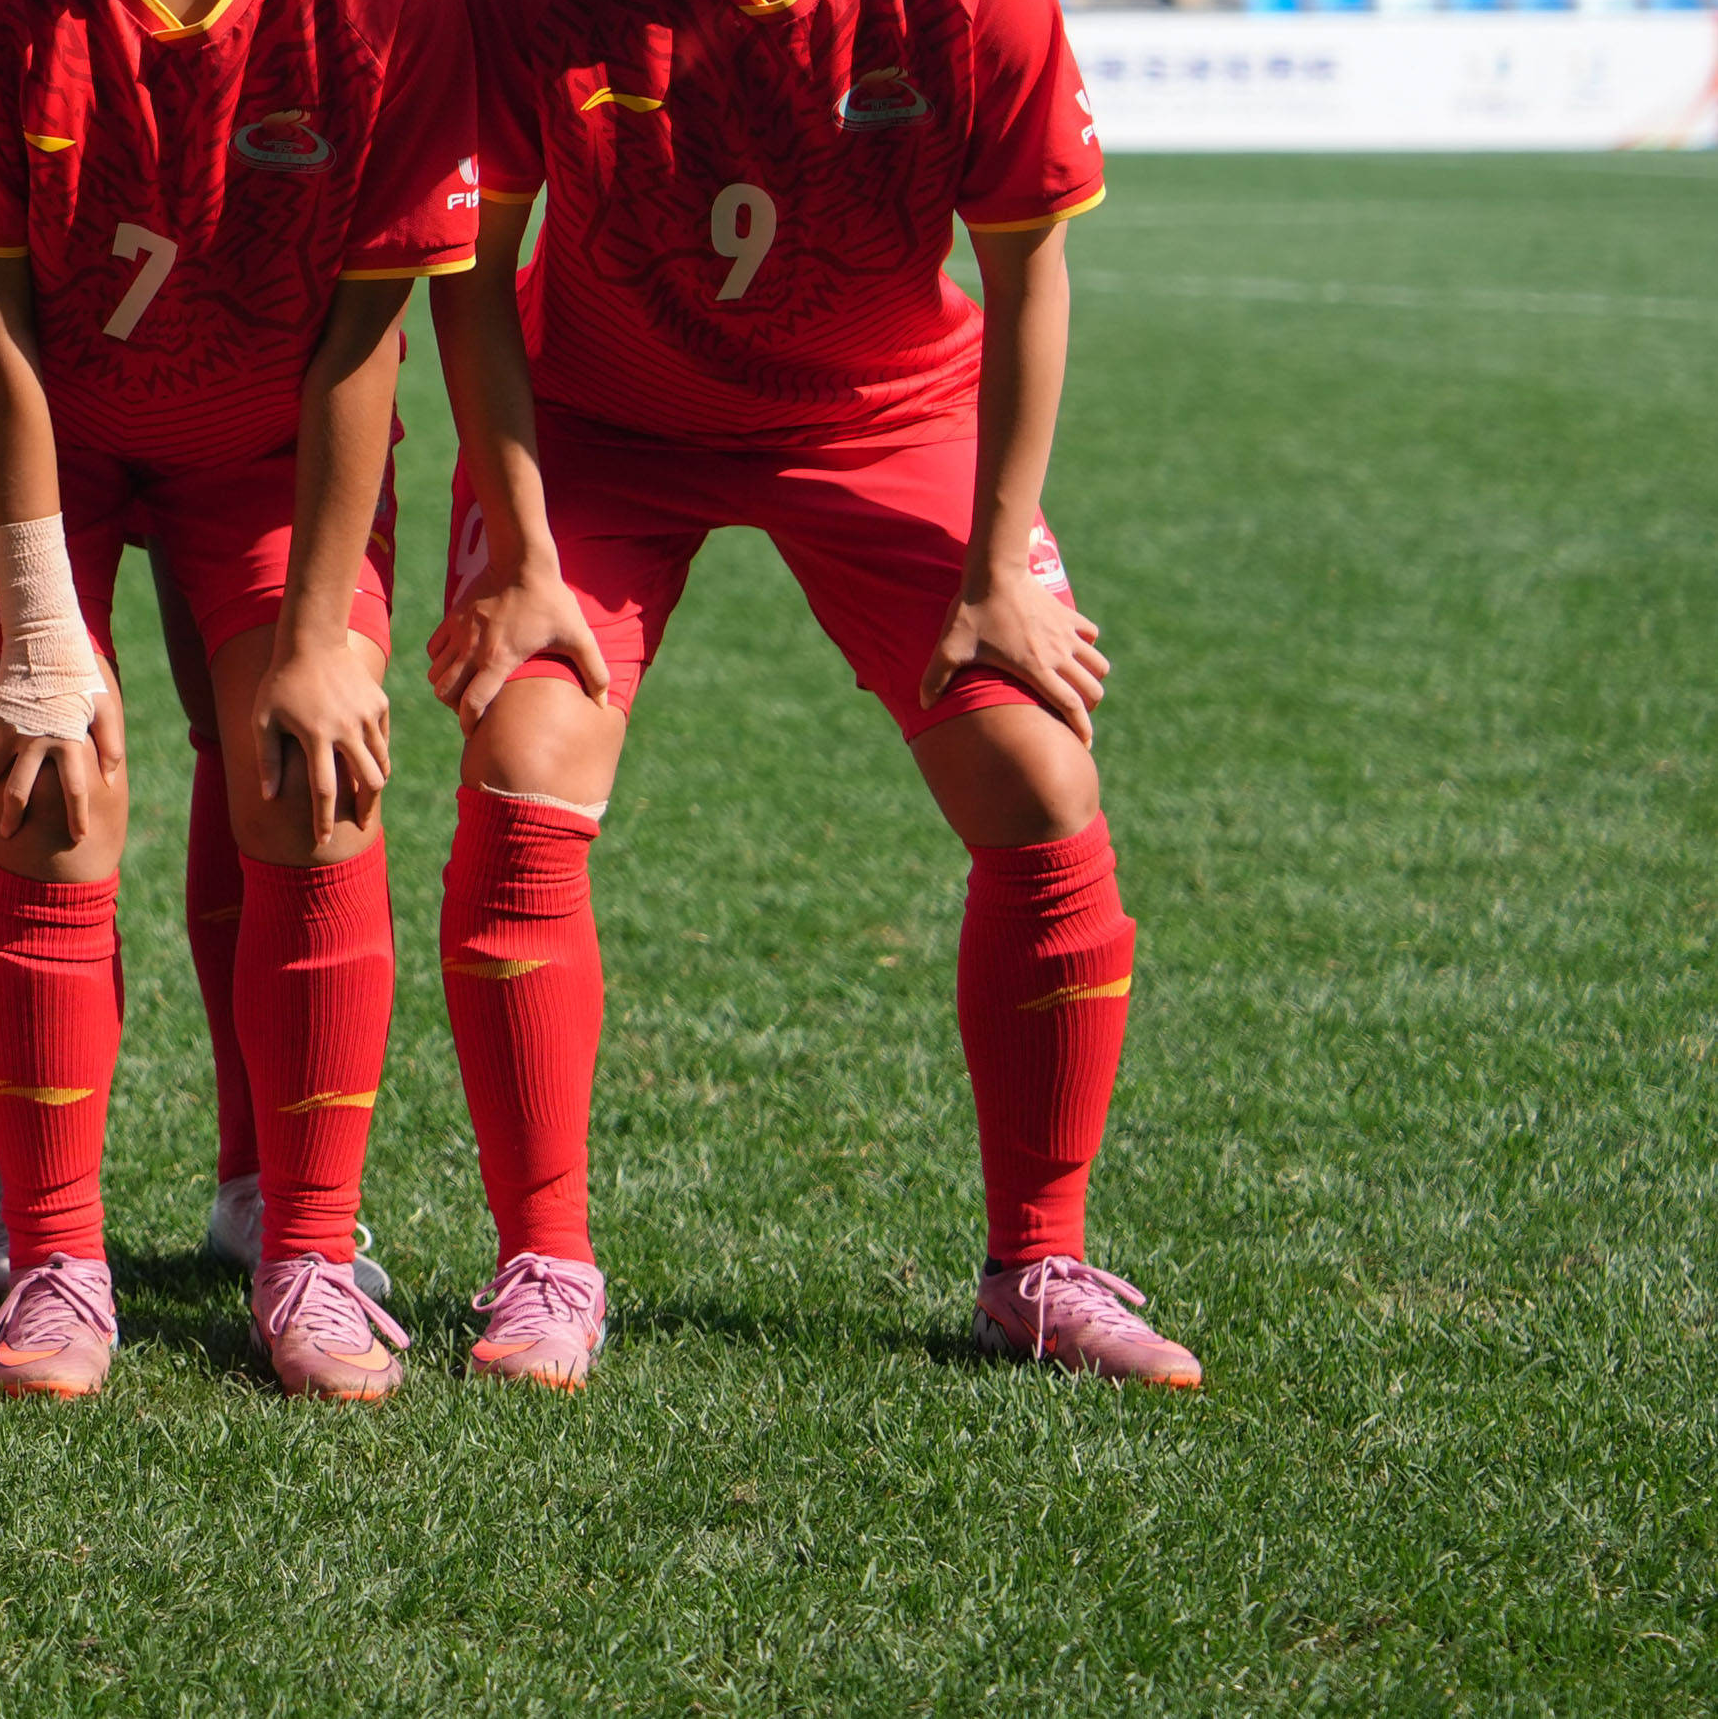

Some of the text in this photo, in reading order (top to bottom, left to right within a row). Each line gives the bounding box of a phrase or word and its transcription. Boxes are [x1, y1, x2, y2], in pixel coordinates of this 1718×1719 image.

[102, 222, 178, 341] 7
[711, 183, 777, 301] 9
[451, 501, 489, 608] 9
